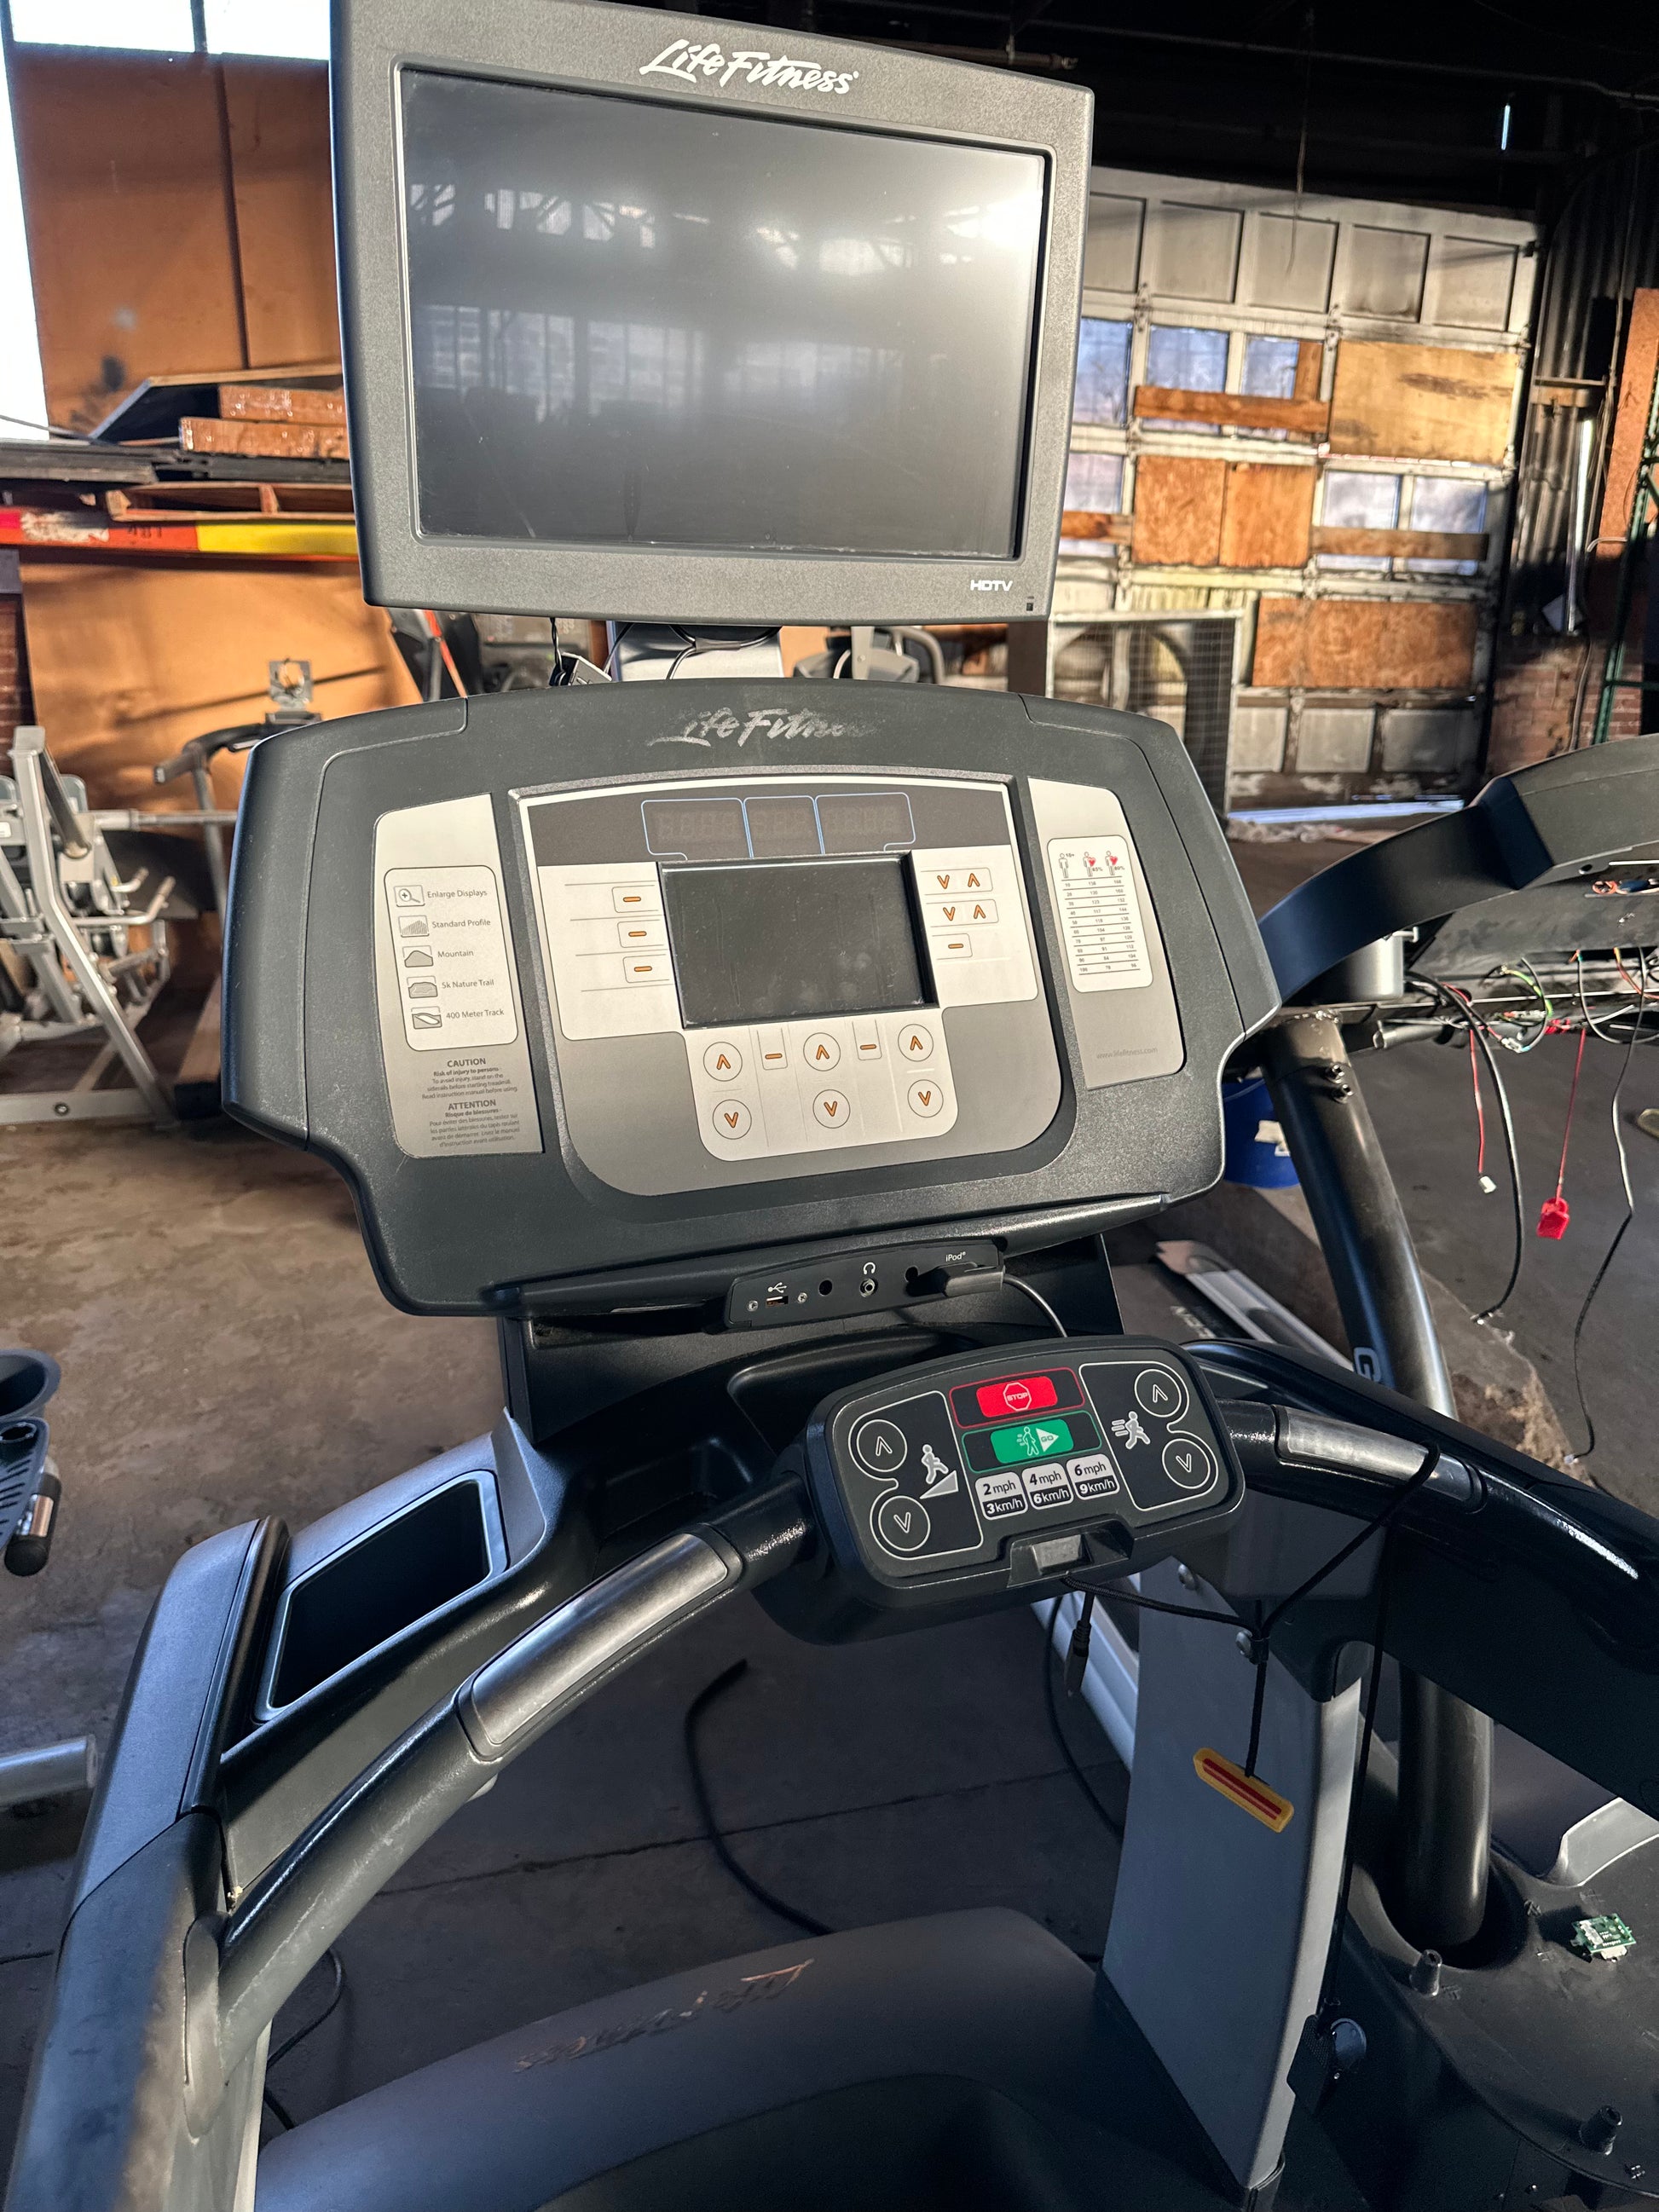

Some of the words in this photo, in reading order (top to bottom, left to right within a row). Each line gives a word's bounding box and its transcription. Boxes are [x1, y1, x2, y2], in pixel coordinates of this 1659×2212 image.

[639, 38, 725, 84] Life
[720, 51, 855, 95] Fitness
[970, 580, 1013, 592] HDTV
[737, 707, 878, 747] Fitne
[457, 889, 488, 898] Displays
[447, 1058, 487, 1068] CAUTION
[448, 1099, 497, 1111] ATTENTION
[1006, 1392, 1029, 1401] STOP
[1074, 1464, 1083, 1476] 6
[1084, 1461, 1107, 1476] mph
[1029, 1473, 1038, 1486] 4
[1038, 1470, 1062, 1485] mph
[983, 1483, 991, 1496] 2
[992, 1480, 1017, 1494] mph
